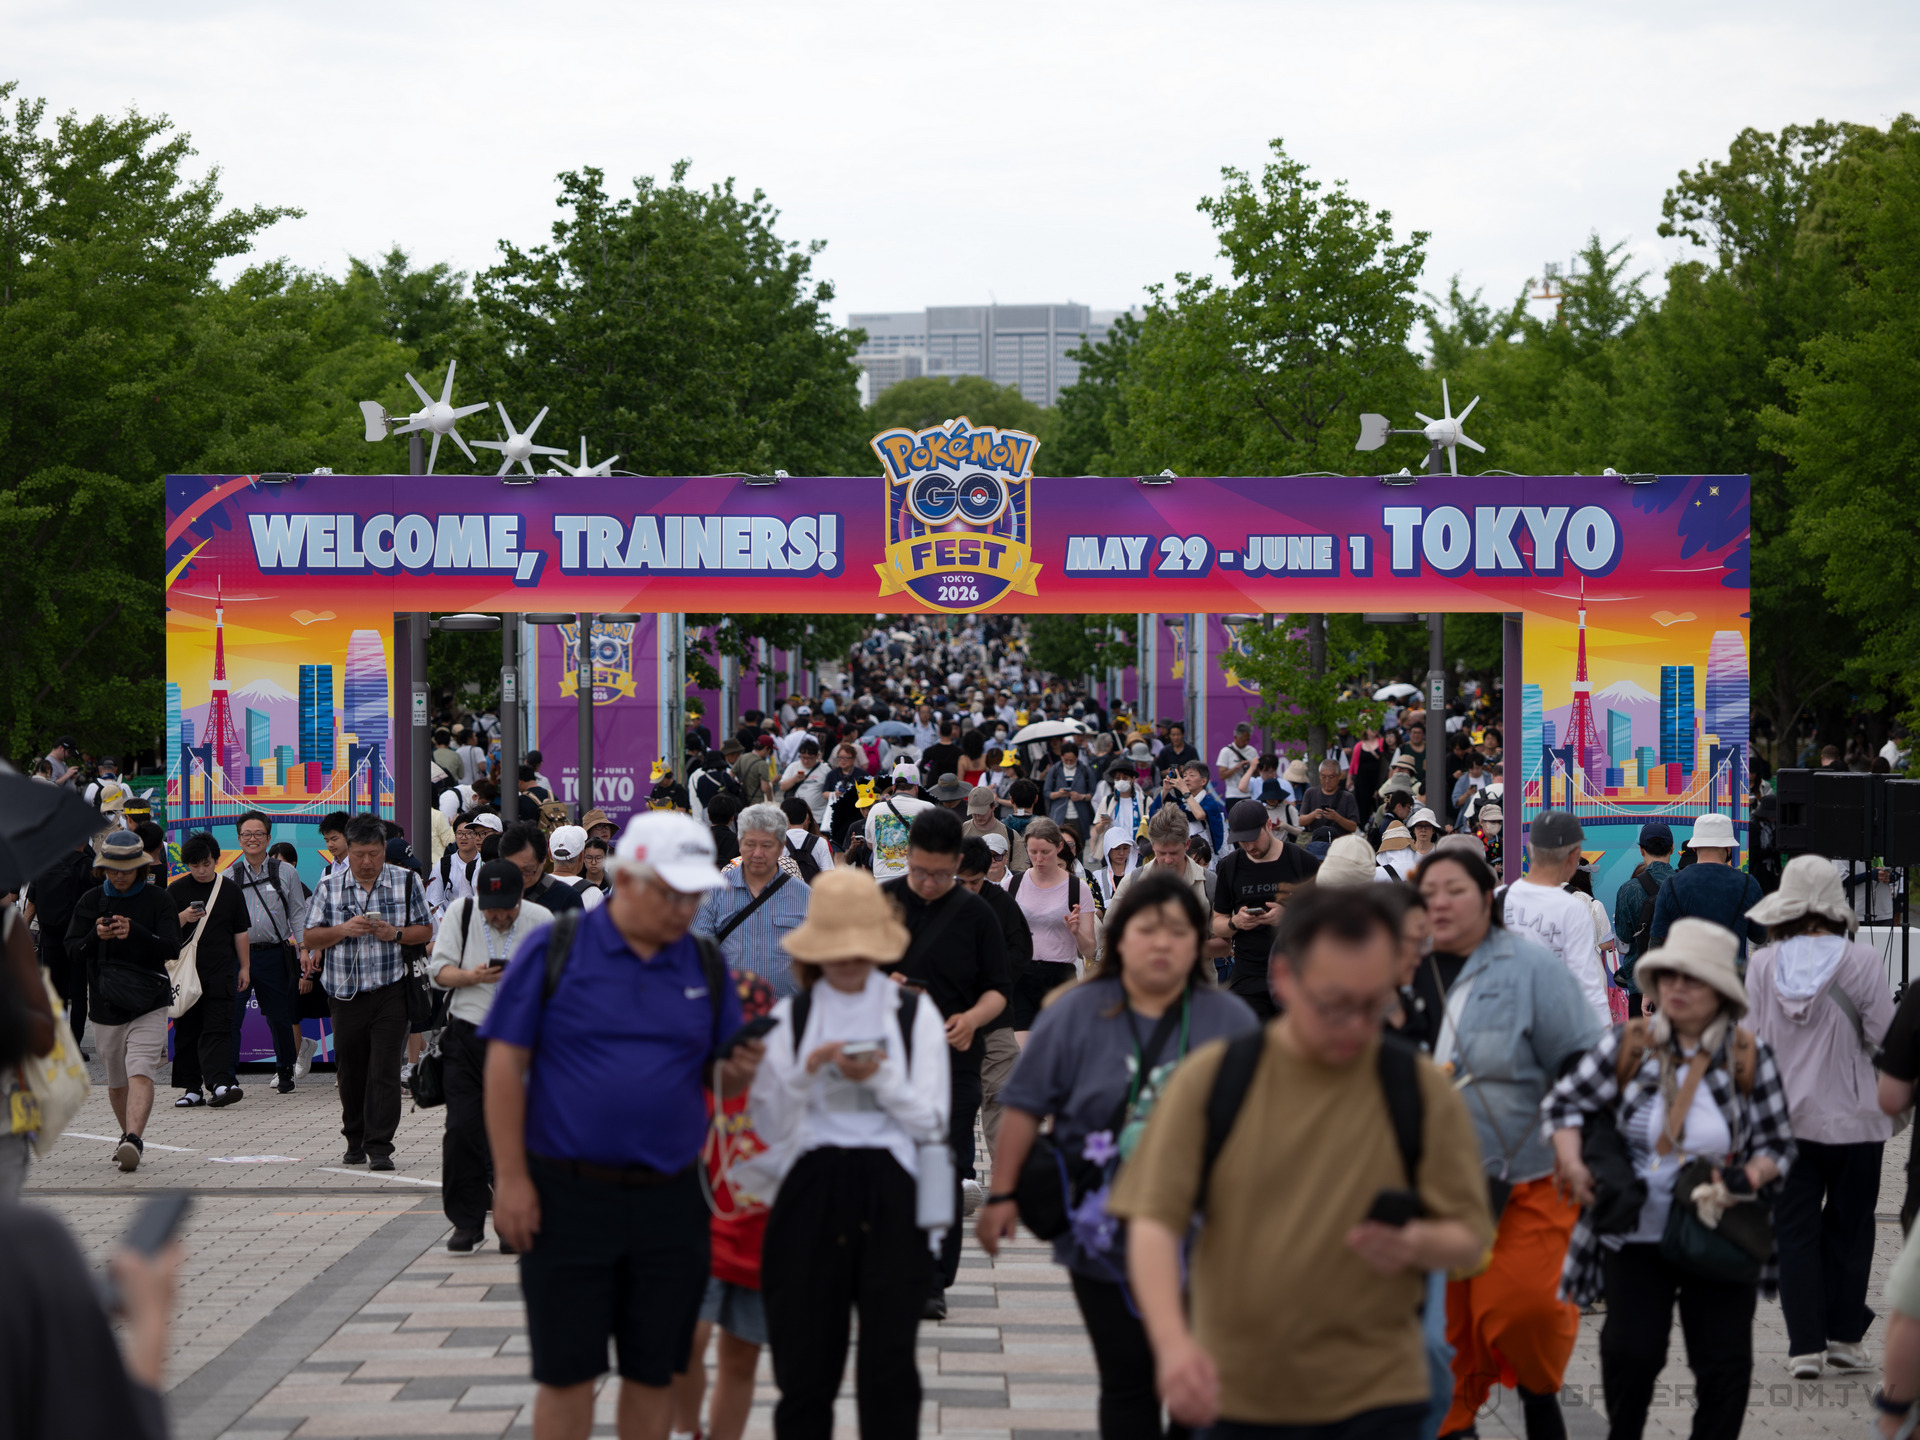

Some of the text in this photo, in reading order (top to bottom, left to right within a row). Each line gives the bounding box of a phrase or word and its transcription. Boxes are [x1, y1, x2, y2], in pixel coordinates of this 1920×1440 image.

[912, 473, 1003, 519] GO
[248, 513, 837, 581] WELCOME, TRAINERS!
[1065, 536, 1147, 571] MAY
[1158, 535, 1204, 571] 29
[1243, 536, 1333, 571] JUNE
[1350, 536, 1366, 571] 1
[1383, 505, 1616, 571] TOKYO
[911, 539, 1007, 571] FEST
[942, 575, 975, 583] TOKYO
[938, 586, 979, 601] 2026
[592, 692, 608, 700] 026
[1242, 883, 1278, 894] FZ FOR
